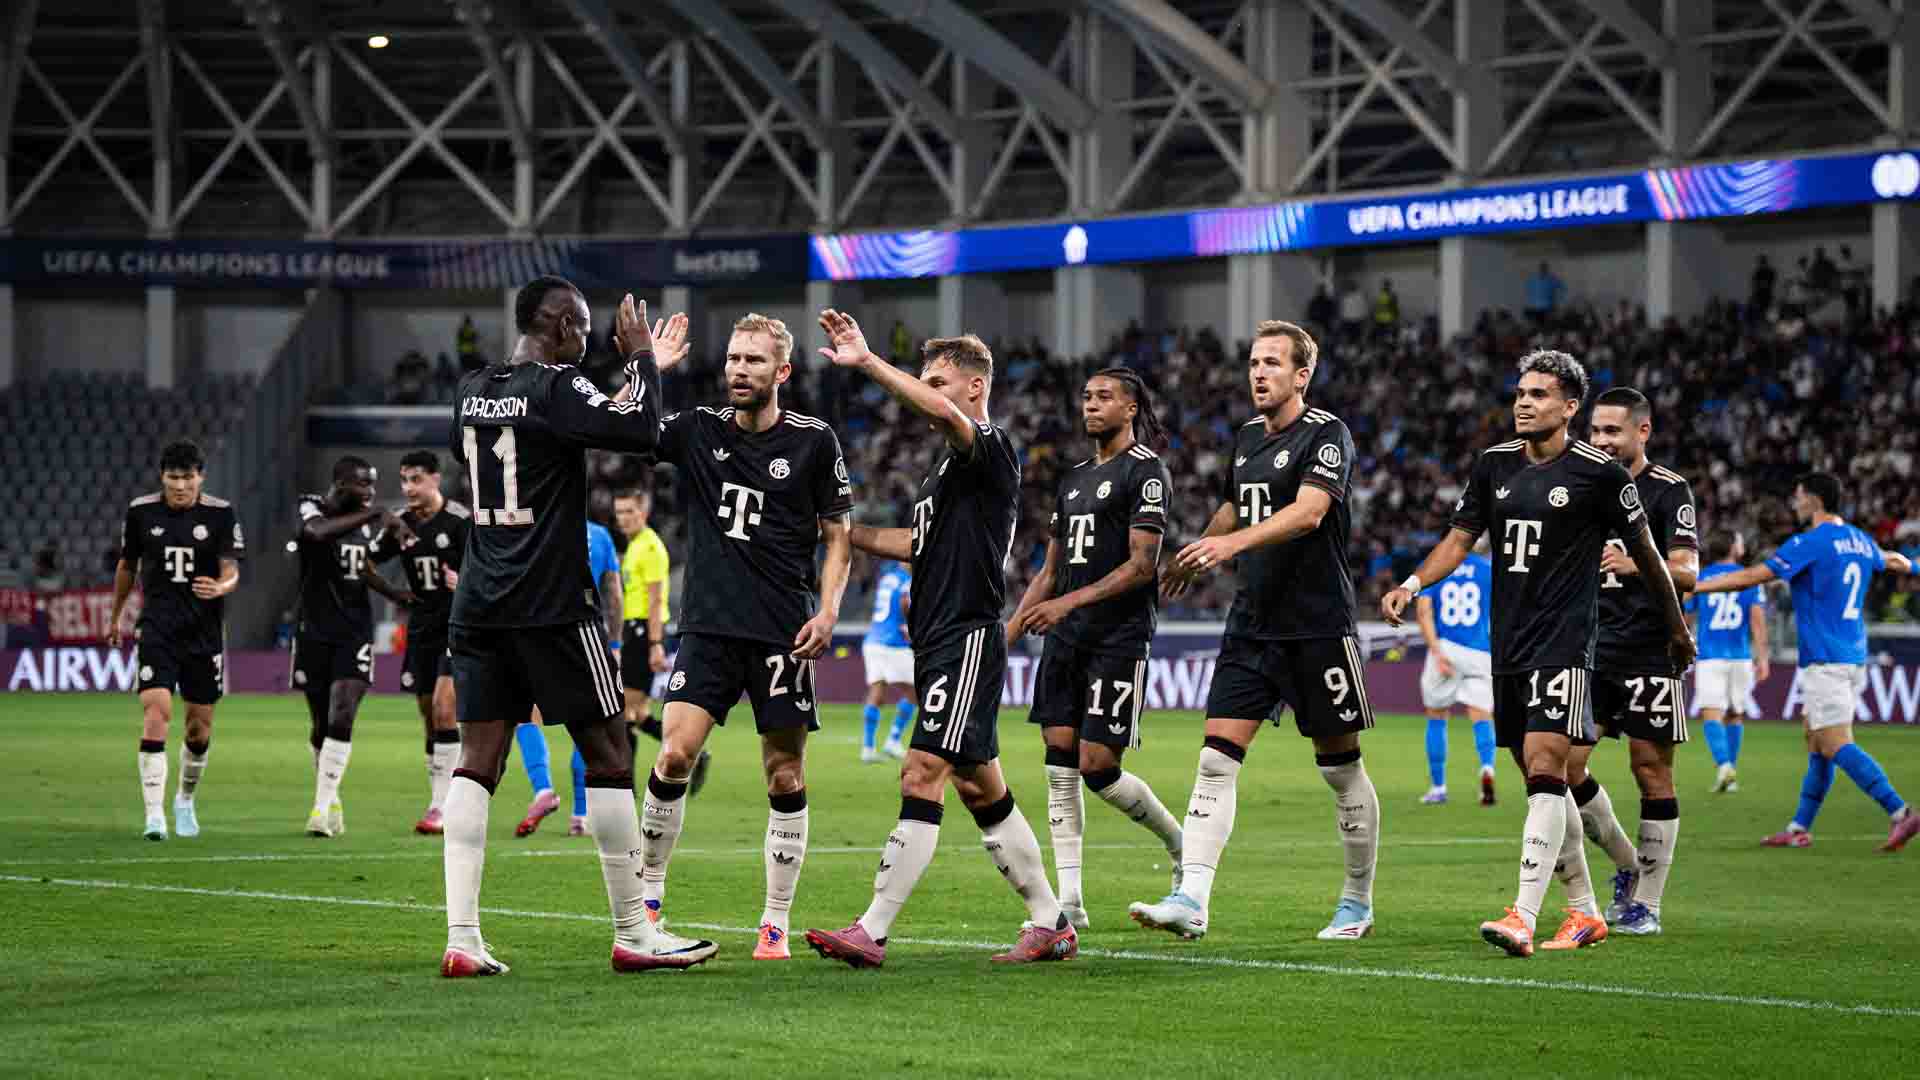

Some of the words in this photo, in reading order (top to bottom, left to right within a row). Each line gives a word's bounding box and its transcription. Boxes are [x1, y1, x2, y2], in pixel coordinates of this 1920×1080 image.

[1348, 205, 1405, 234] UEFA
[1405, 191, 1537, 230] CHAMPIONS
[1540, 184, 1630, 219] LEAGUE
[43, 250, 112, 273] UEFA
[119, 251, 279, 276] CHAMPIONS
[285, 252, 390, 278] LEAGUE
[463, 425, 535, 526] 11
[716, 481, 765, 542] T
[1067, 513, 1096, 565] T
[1503, 519, 1543, 573] T
[164, 546, 195, 583] T
[1440, 581, 1481, 627] 88
[1708, 591, 1743, 630] 26
[1842, 562, 1862, 620] 2
[765, 654, 808, 697] 27
[923, 675, 948, 713] 6
[1324, 666, 1350, 705] 9
[1527, 669, 1569, 707] 14
[1625, 676, 1672, 712] 22
[1087, 678, 1133, 717] 17
